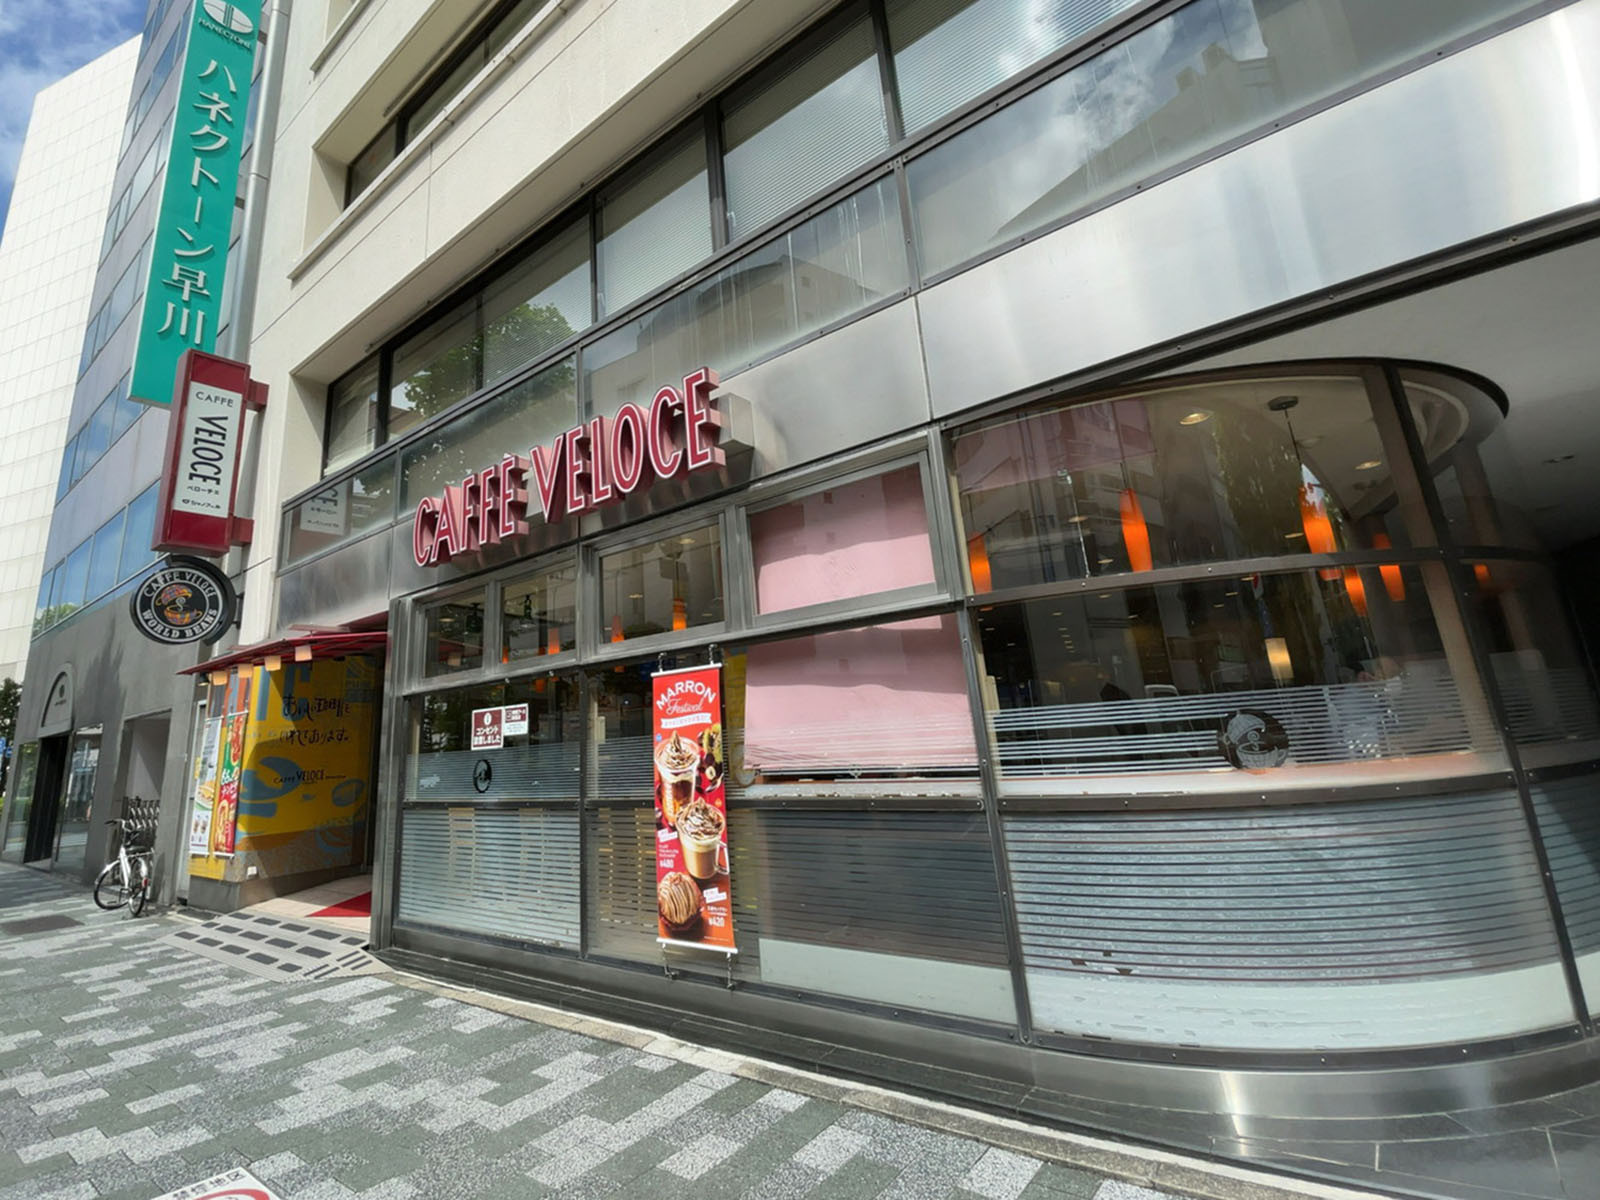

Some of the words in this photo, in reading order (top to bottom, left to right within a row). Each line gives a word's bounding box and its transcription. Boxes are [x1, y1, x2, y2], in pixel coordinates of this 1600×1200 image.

[198, 17, 251, 49] HANECTONE
[157, 58, 237, 345] ハネクトーン早川
[188, 415, 228, 485] VELOCE
[530, 366, 724, 524] VELOCE
[186, 572, 217, 598] VELOCE
[142, 609, 180, 639] WORLD
[185, 609, 217, 638] BEANS
[656, 680, 717, 711] MARRON
[665, 696, 704, 715] Festival
[475, 725, 499, 736] コンセント
